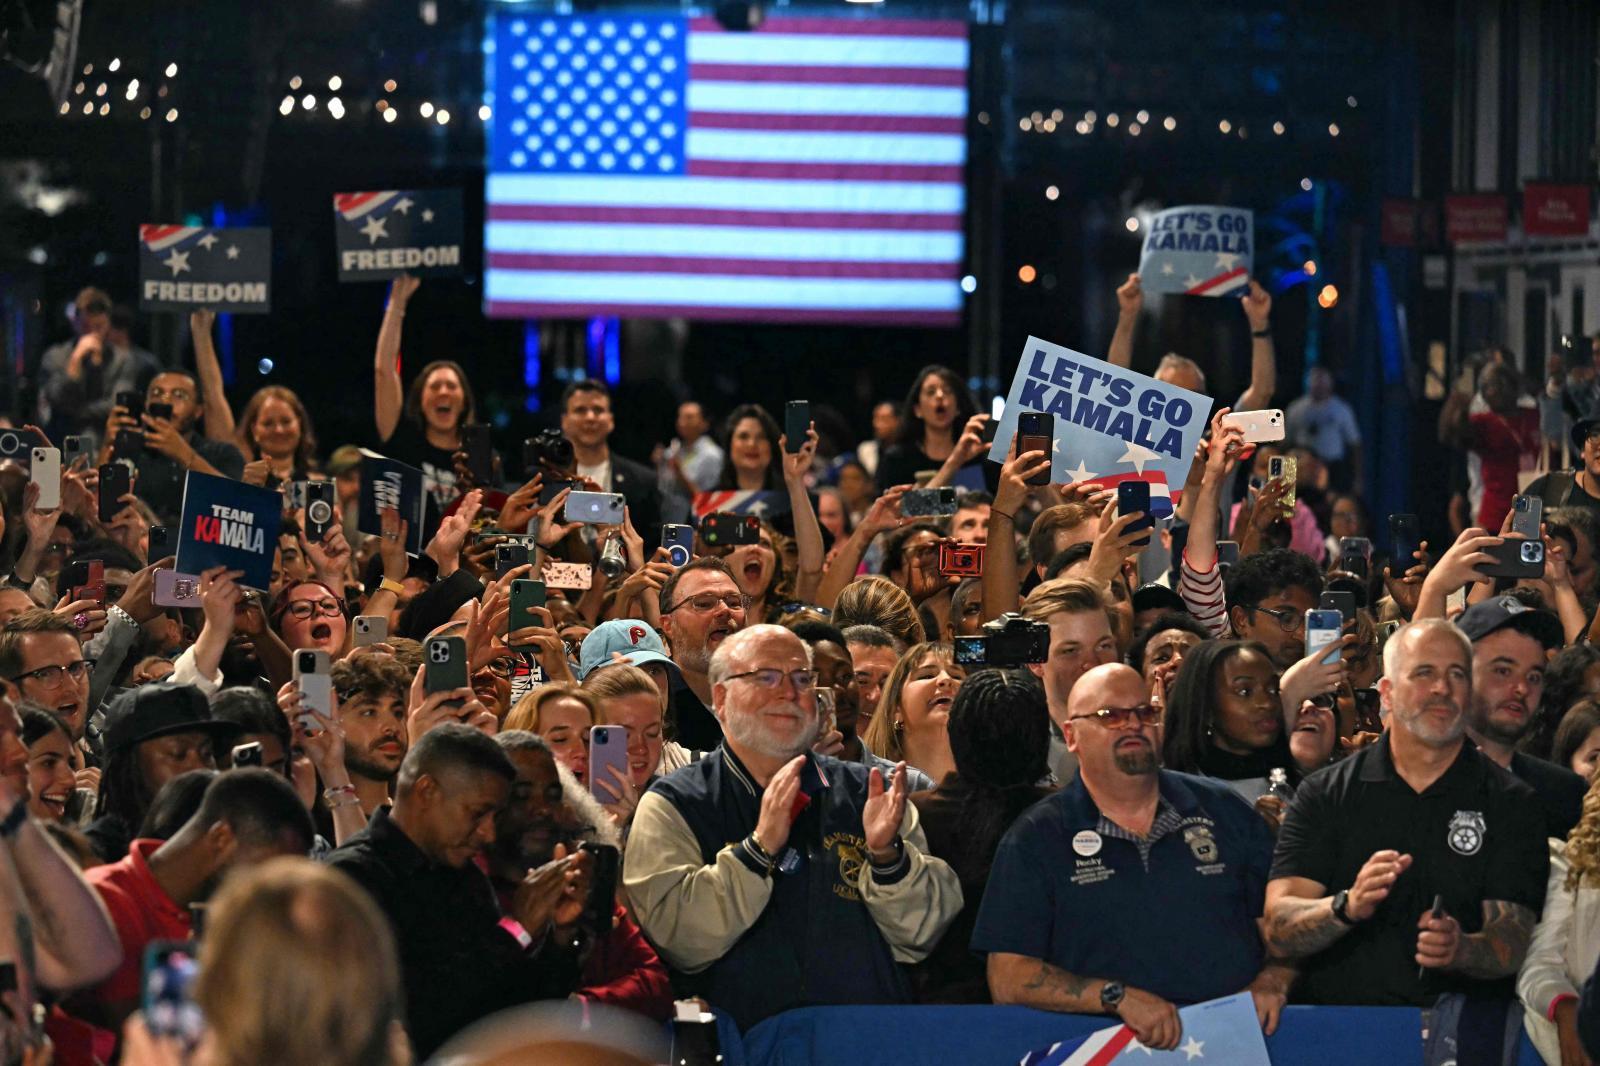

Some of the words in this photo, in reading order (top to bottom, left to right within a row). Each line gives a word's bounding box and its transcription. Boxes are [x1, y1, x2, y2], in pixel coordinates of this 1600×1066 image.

[1151, 213, 1212, 232] LET'S
[1217, 213, 1247, 233] GO
[1146, 232, 1249, 256] KAMALA
[341, 245, 460, 271] FREEDOM
[143, 281, 267, 303] FREEDOM
[1018, 377, 1183, 460] KAMALA
[1137, 389, 1193, 427] GO
[211, 504, 254, 525] TEAM
[194, 514, 264, 555] KAMALA
[530, 666, 543, 690] TEA
